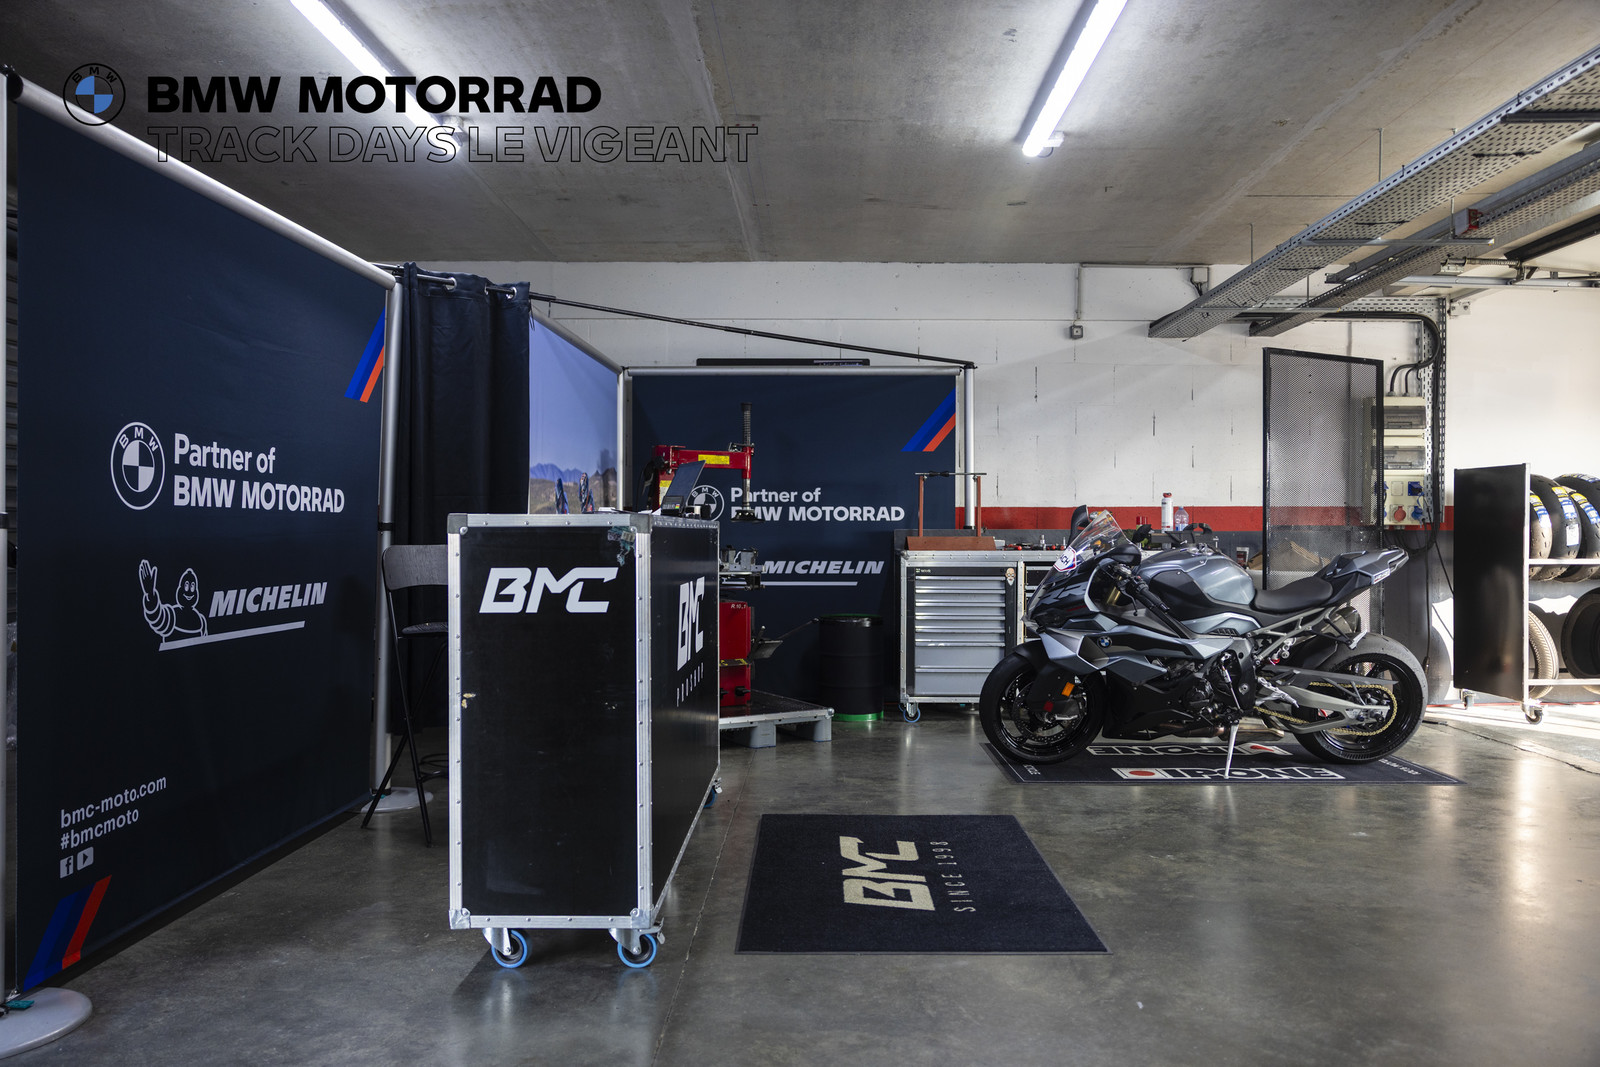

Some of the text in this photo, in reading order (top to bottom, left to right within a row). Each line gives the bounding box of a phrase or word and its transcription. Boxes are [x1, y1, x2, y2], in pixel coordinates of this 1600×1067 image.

[118, 427, 159, 452] BMW
[174, 433, 276, 474] Partner of
[174, 475, 345, 513] BMW MOTORRAD
[788, 506, 905, 521] MOTORRAD
[802, 487, 821, 502] of
[761, 560, 885, 574] MICHELIN
[208, 582, 328, 618] MICHELIN
[479, 567, 619, 613] BMC
[677, 576, 705, 671] BMC
[1159, 767, 1346, 779] IPONE
[61, 777, 167, 828] bmc-moto.com
[61, 809, 139, 850] #bmcmoto
[839, 836, 935, 911] BMC
[930, 841, 976, 912] SINCE 1998
